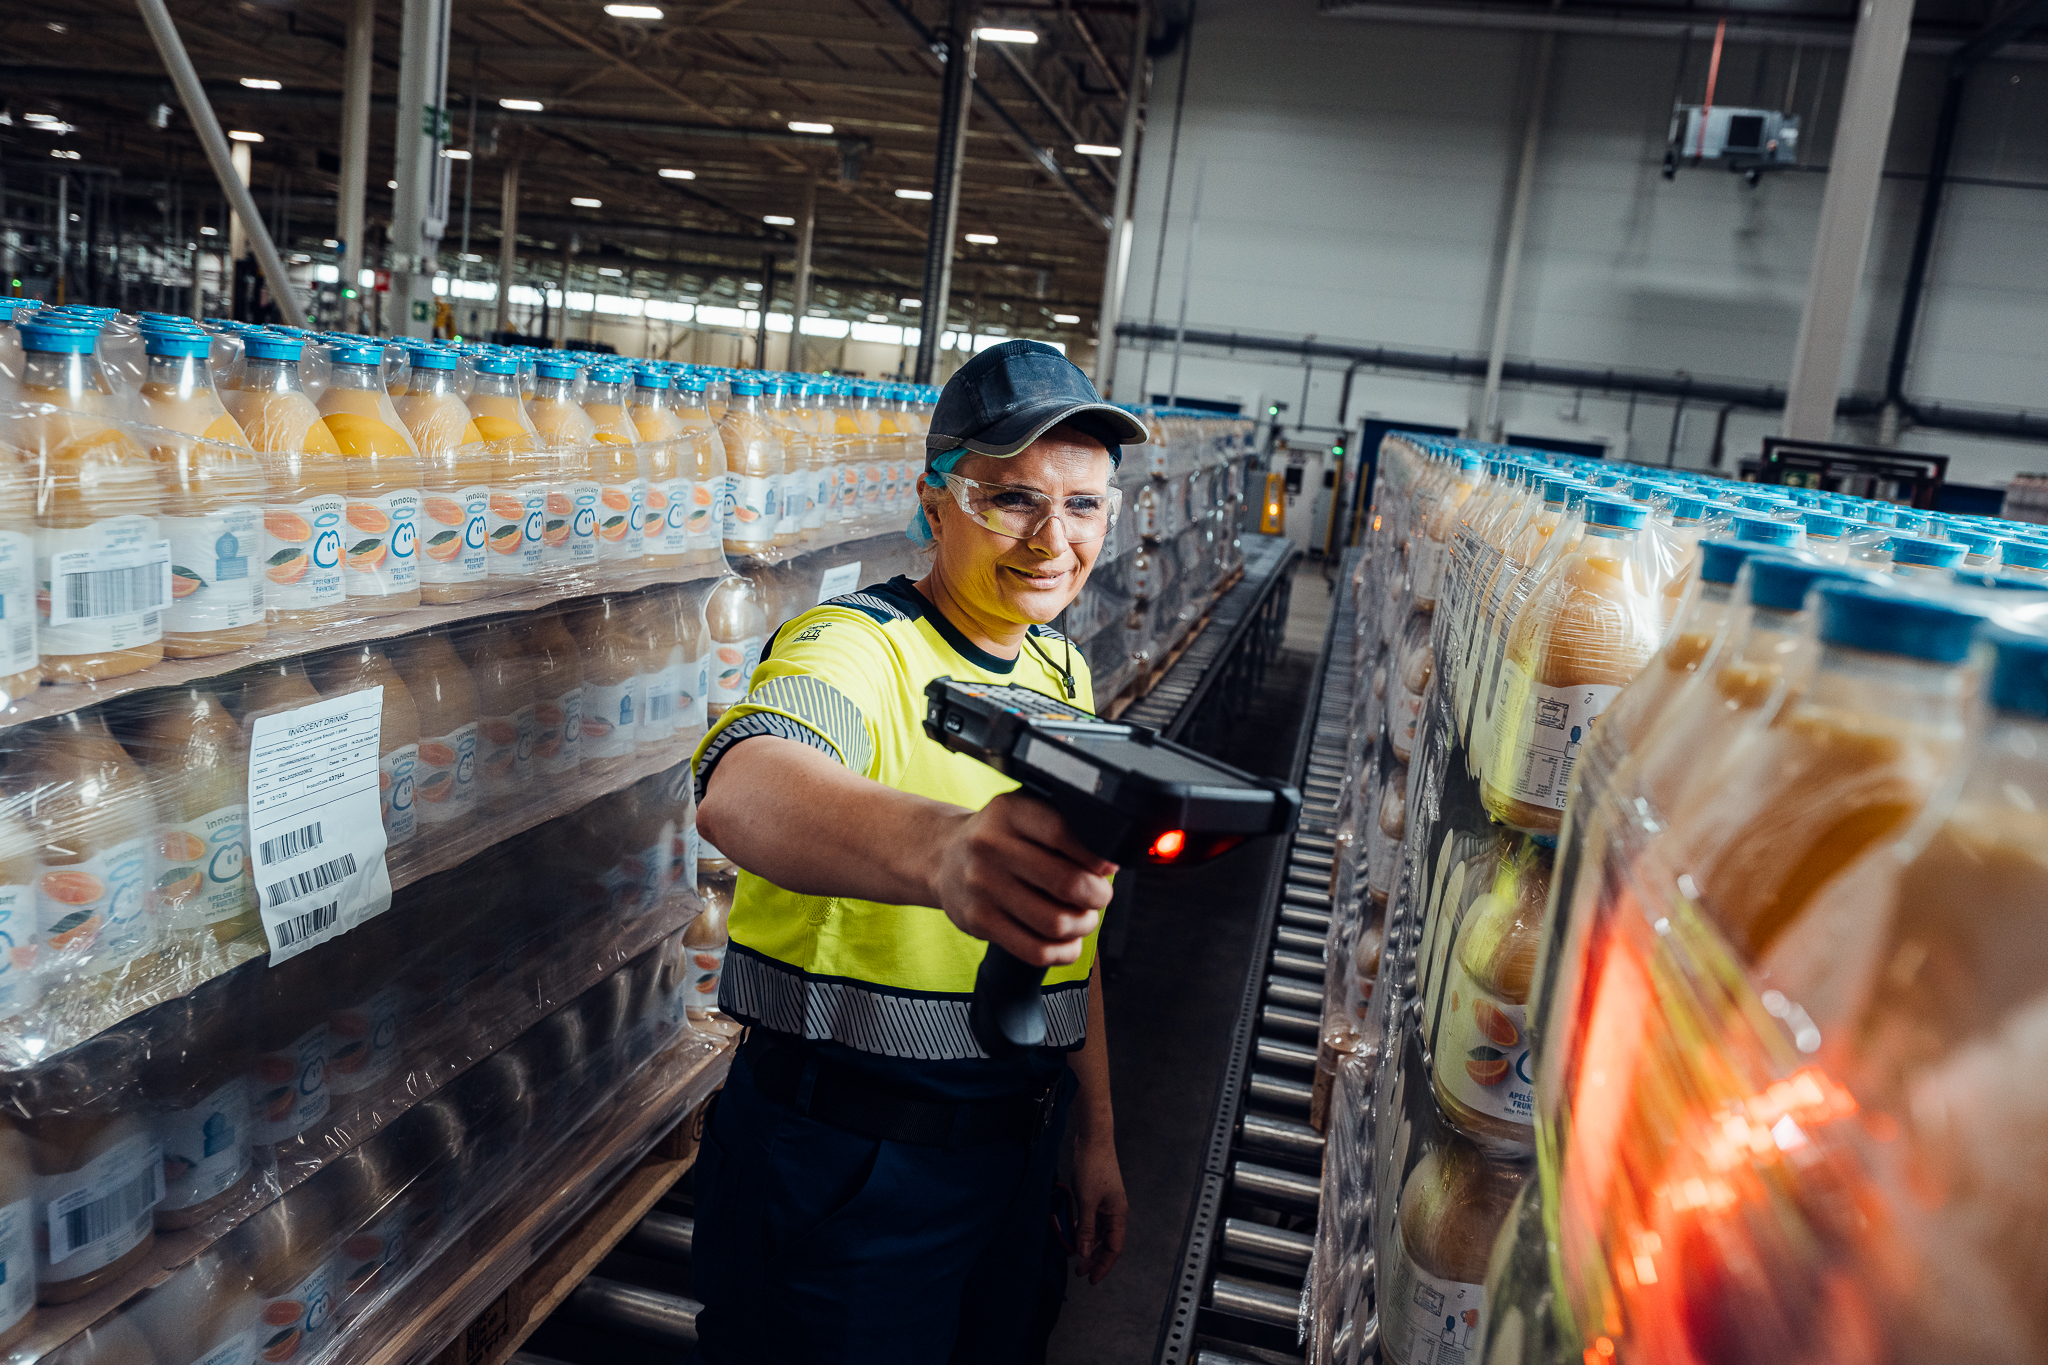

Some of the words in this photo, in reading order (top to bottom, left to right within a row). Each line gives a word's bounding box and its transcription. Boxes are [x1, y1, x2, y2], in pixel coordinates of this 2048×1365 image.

[390, 496, 418, 507] innocent
[466, 492, 488, 502] innocent
[311, 502, 342, 513] innocent
[288, 720, 322, 736] INNOCENT
[323, 713, 348, 726] DRINKS
[1555, 797, 1566, 808] 1,5
[208, 890, 232, 903] APELSIN
[1509, 1092, 1533, 1102] APELSI
